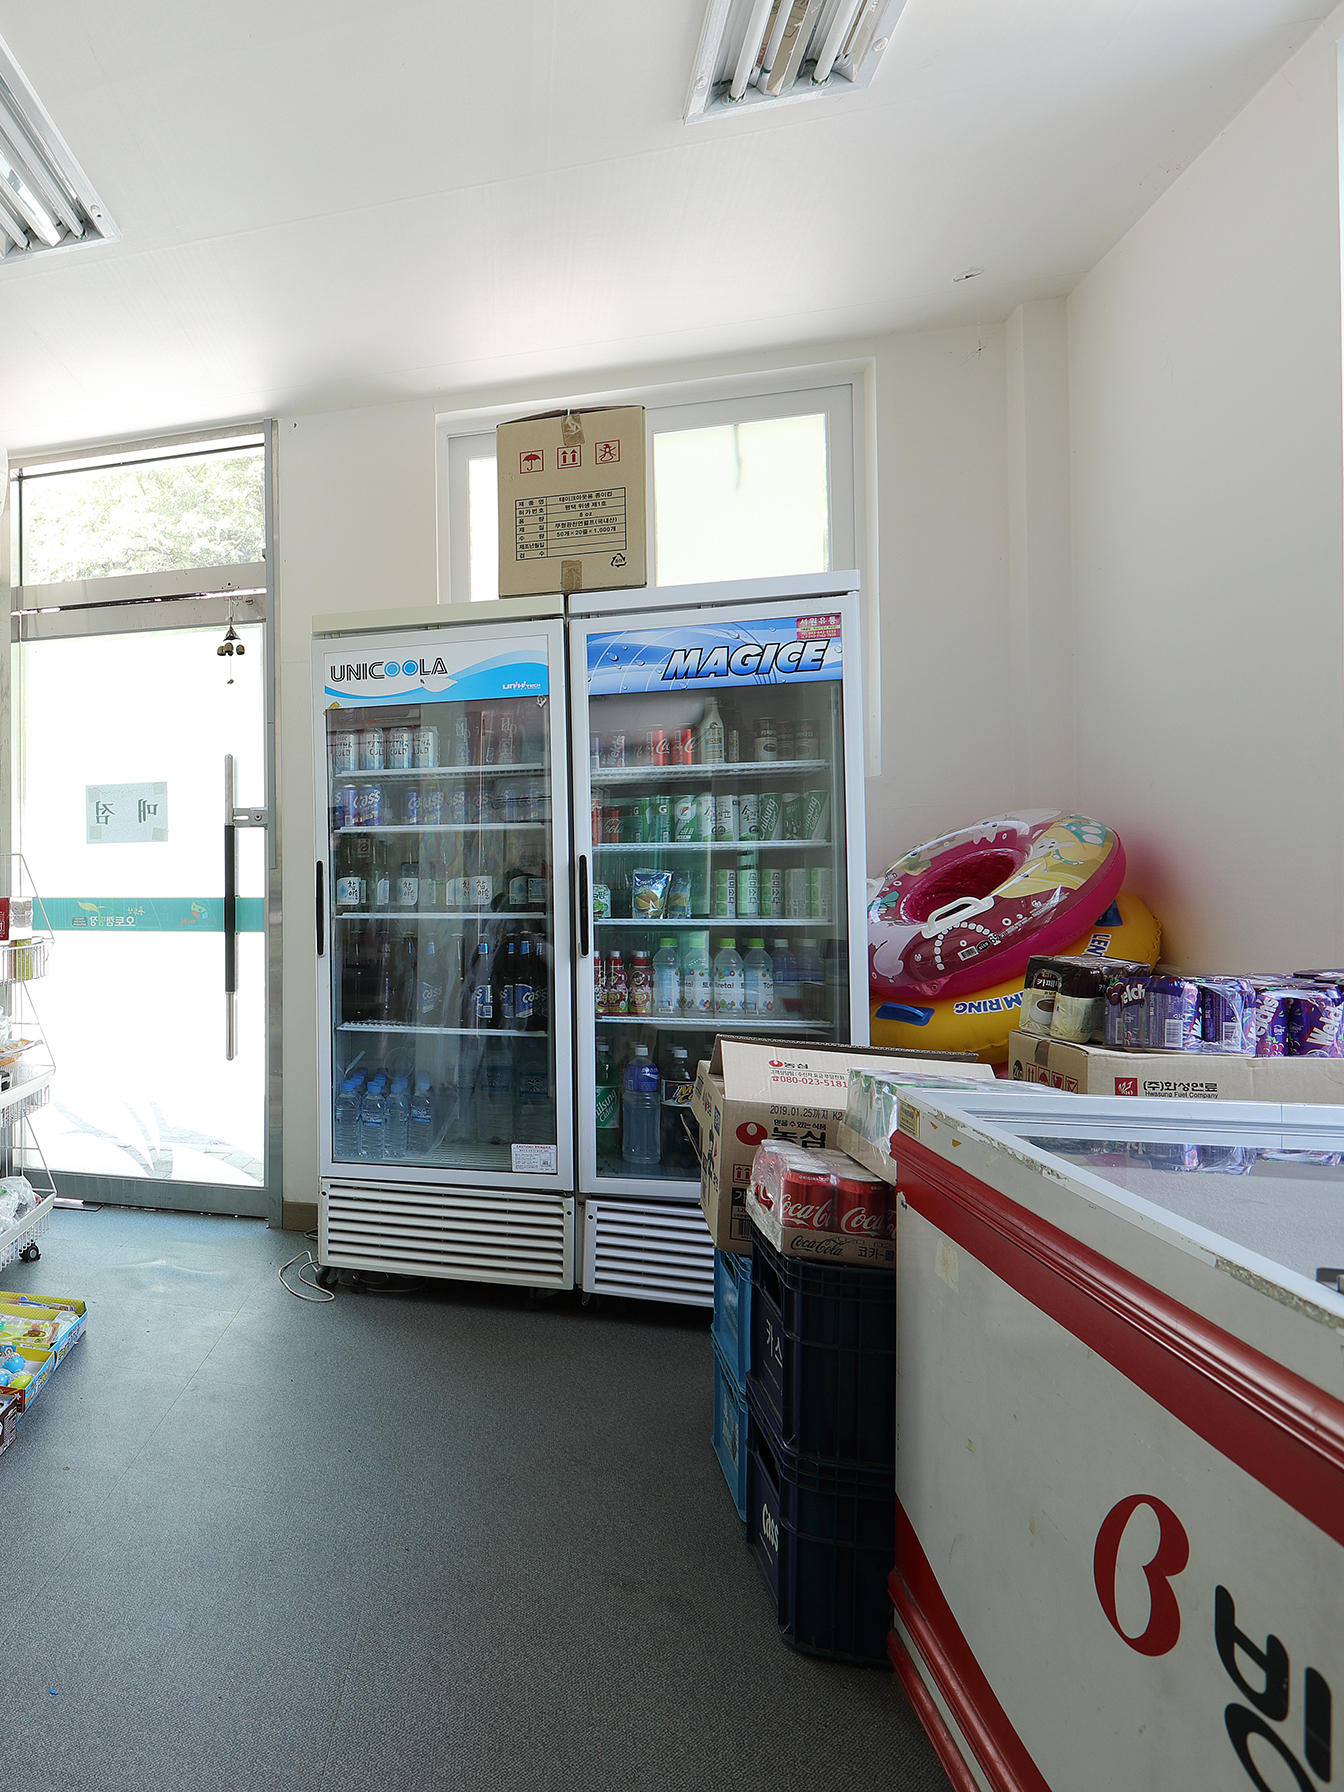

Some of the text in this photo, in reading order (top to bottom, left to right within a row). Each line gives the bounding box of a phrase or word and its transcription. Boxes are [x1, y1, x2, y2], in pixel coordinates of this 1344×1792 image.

[799, 616, 837, 626] 서원유통
[662, 638, 832, 681] MAGICE
[330, 656, 449, 684] UNICOOLA
[955, 997, 1003, 1015] RING
[783, 1061, 809, 1070] 농심
[779, 1075, 848, 1088] 080-023-5181
[1143, 1080, 1219, 1093] (주)화성연료
[1144, 1091, 1173, 1099] Hwasung
[1189, 1091, 1219, 1100] Company
[770, 1105, 829, 1119] 2019.01.25까지
[790, 1235, 845, 1257] Coca-Cola
